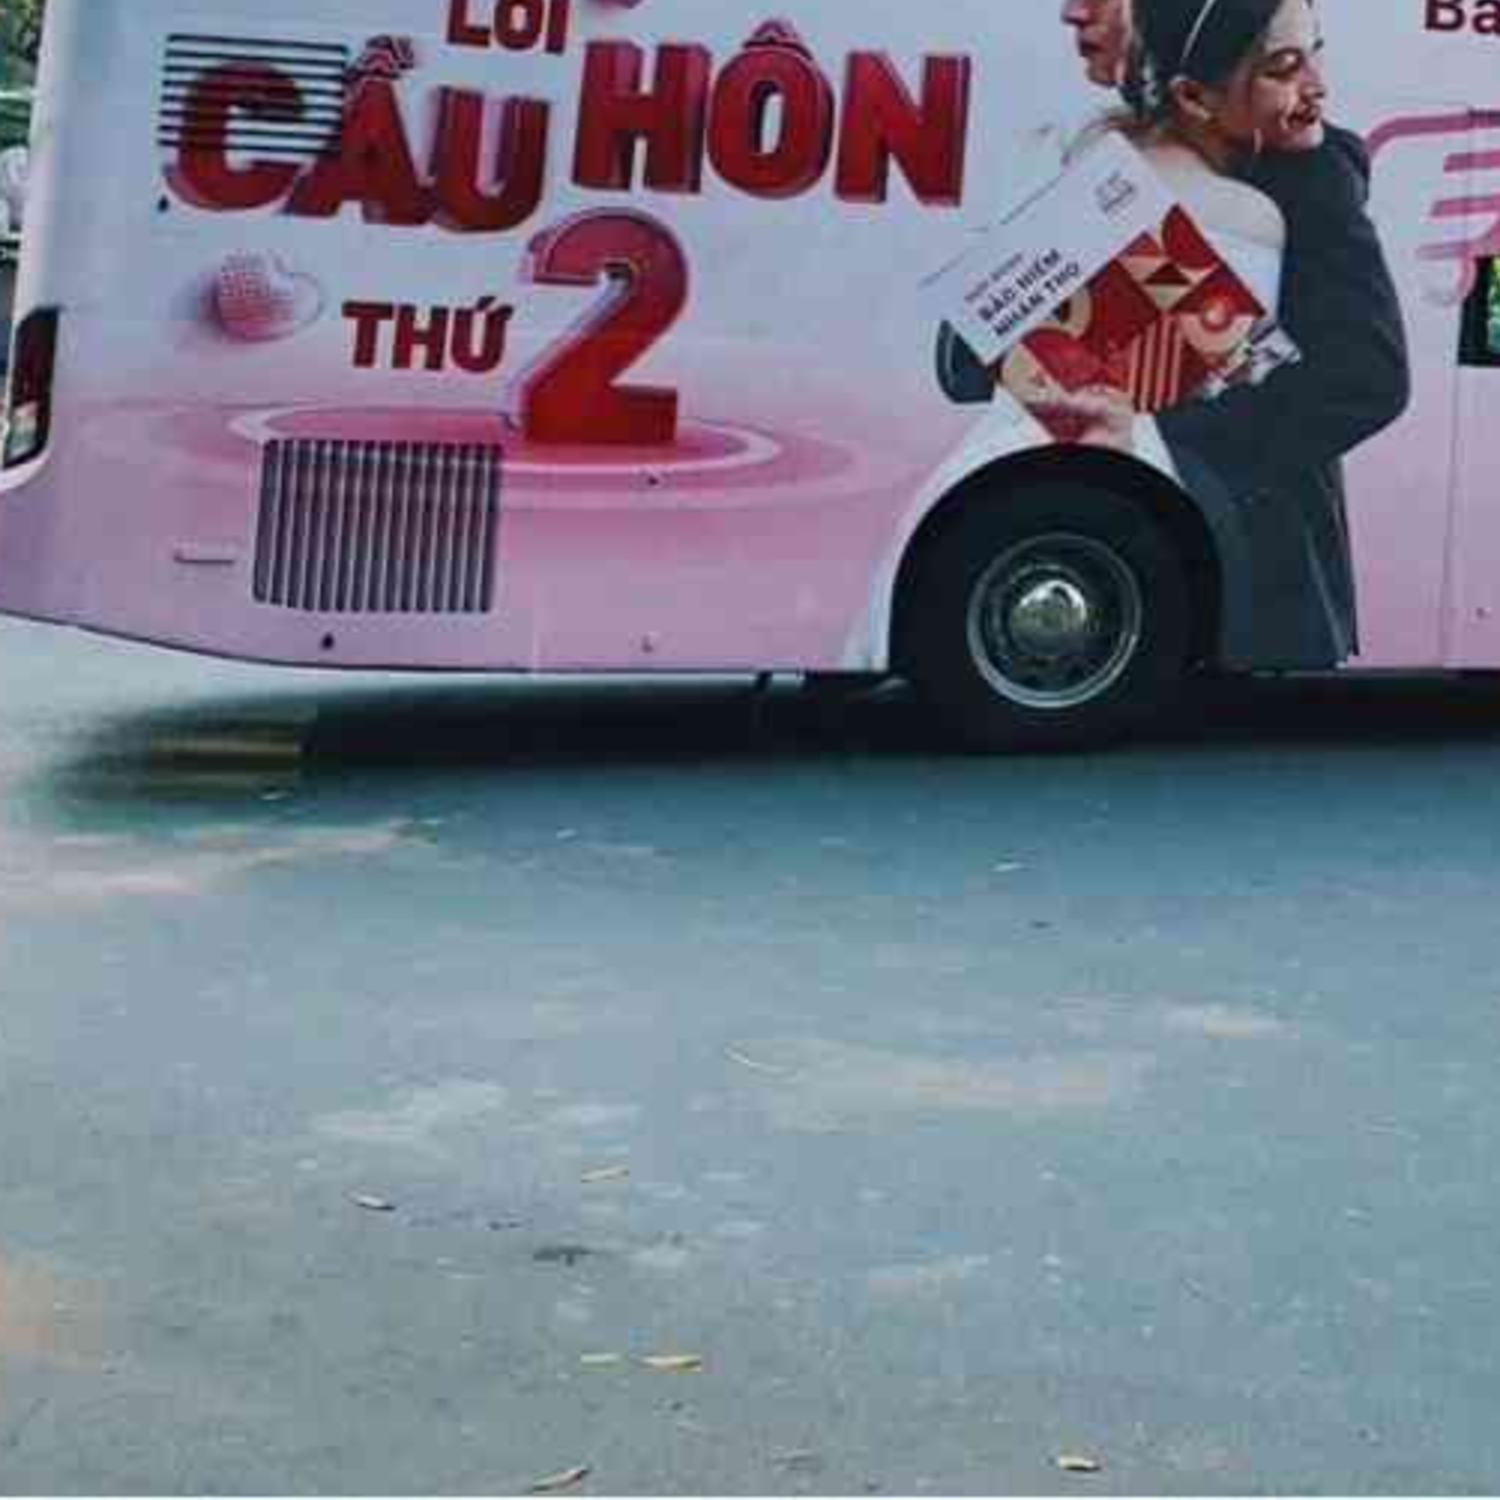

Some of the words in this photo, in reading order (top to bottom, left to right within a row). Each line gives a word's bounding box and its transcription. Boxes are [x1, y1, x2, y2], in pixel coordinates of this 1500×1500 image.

[571, 18, 972, 208] HÔN
[342, 296, 514, 372] THỨ
[506, 207, 690, 446] 2
